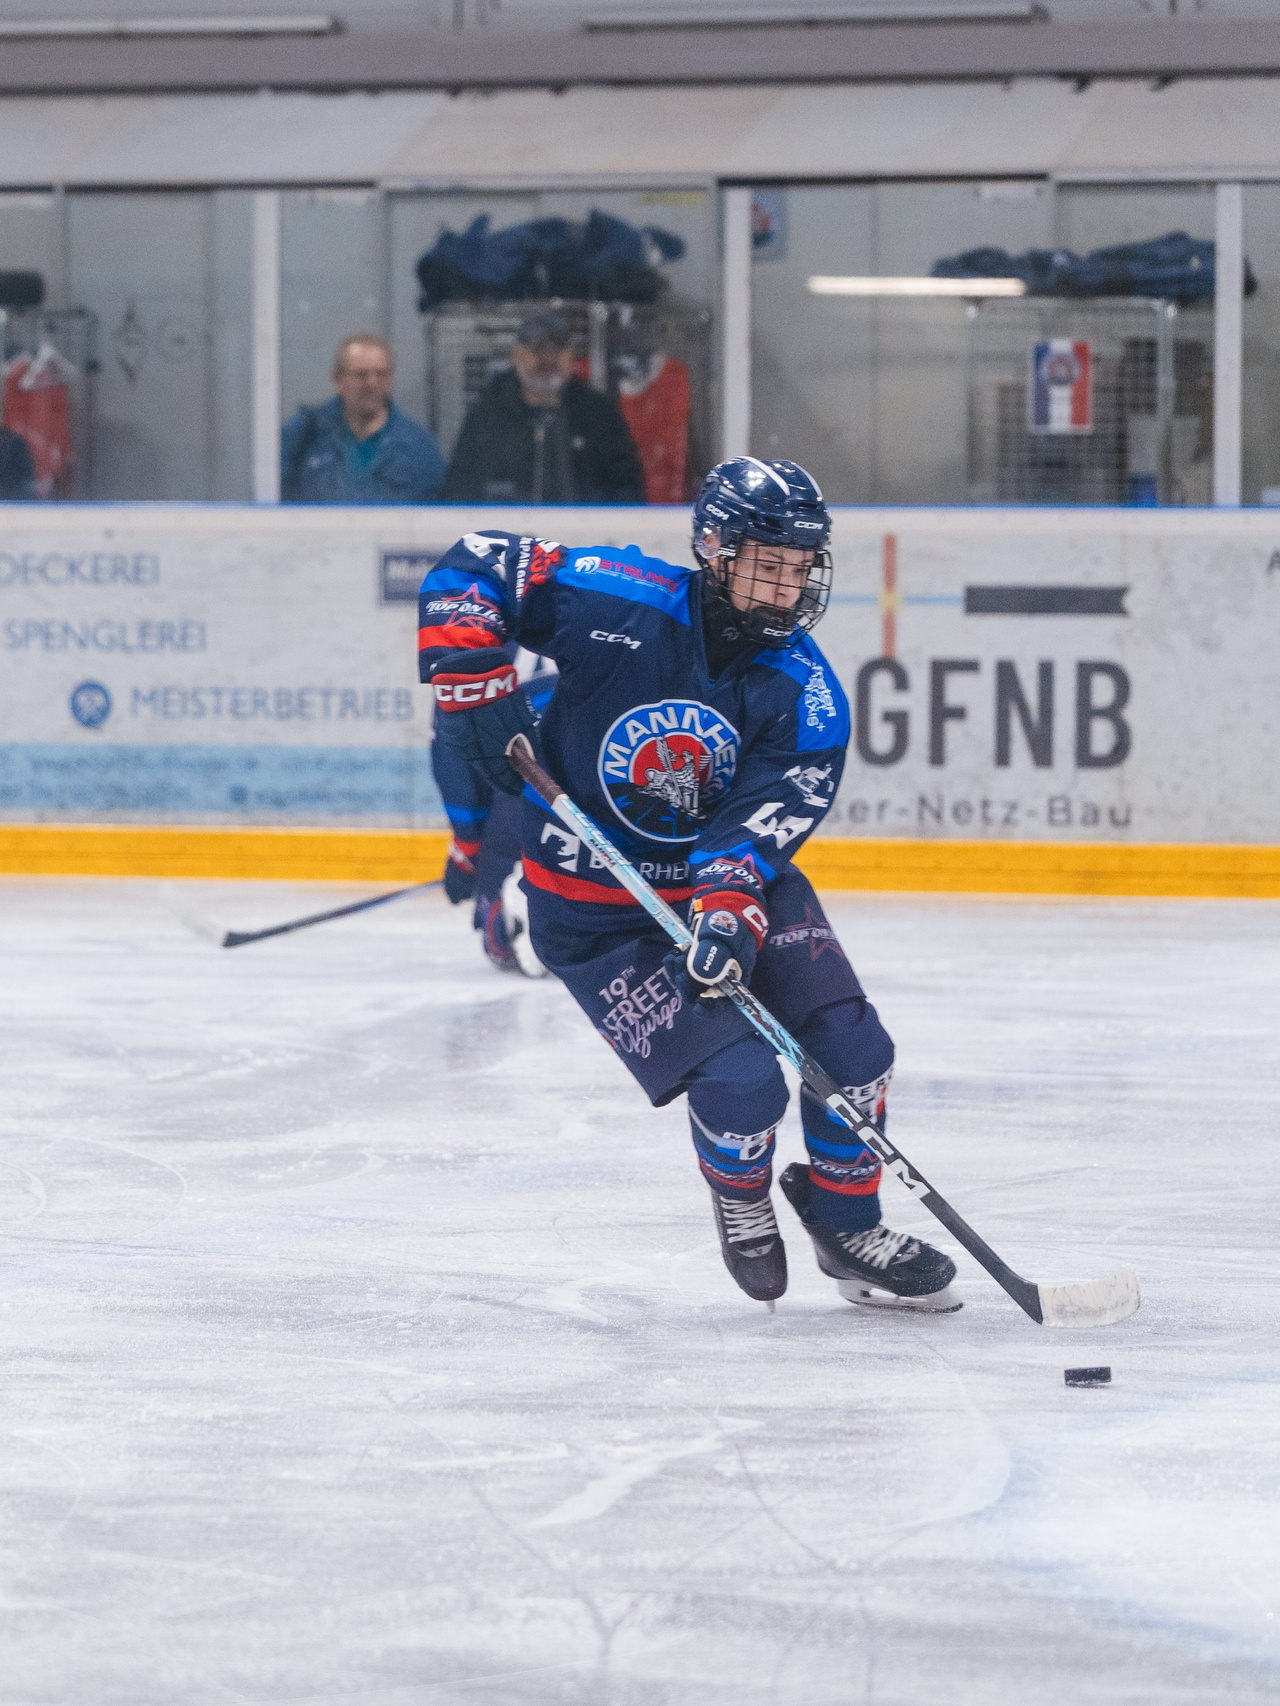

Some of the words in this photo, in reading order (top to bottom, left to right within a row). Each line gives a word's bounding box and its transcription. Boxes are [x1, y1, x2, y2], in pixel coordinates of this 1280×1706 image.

[705, 504, 730, 521] CCM
[793, 520, 825, 530] CCM
[599, 559, 679, 593] STRUWE
[426, 600, 458, 612] TOP
[3, 617, 208, 655] SPENGLEREI
[589, 630, 642, 650] CCM
[434, 672, 516, 703] CCM
[128, 685, 415, 723] MEISTERBETRIEB
[855, 655, 1133, 770] GFNB
[703, 945, 718, 972] CCM
[826, 1093, 932, 1199] CCM
